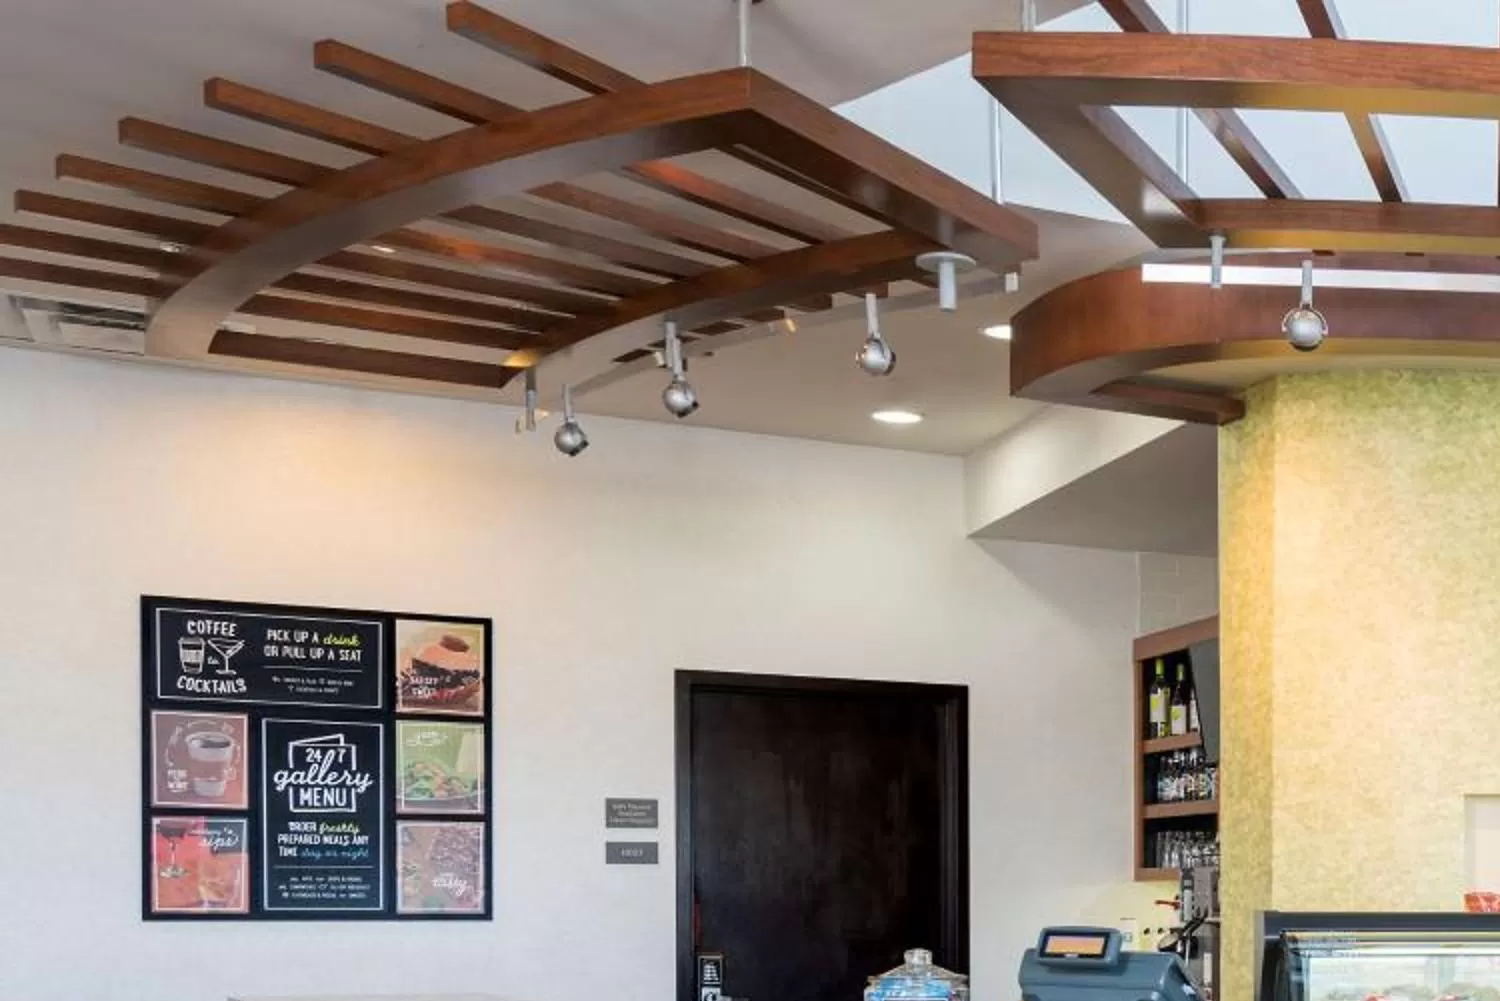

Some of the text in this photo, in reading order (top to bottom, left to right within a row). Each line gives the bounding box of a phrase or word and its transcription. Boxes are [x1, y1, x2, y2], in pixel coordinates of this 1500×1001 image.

[186, 619, 238, 637] COFFEE
[266, 628, 361, 647] PICK UP A drink
[263, 644, 362, 662] OR PULL UP A SEAT
[176, 675, 248, 695] COCKTAILS
[272, 748, 374, 794] gallery
[299, 787, 347, 807] MENU
[287, 821, 318, 833] ORDER
[277, 833, 321, 846] PREPARED
[322, 834, 350, 847] MEALS
[278, 845, 298, 857] TIME
